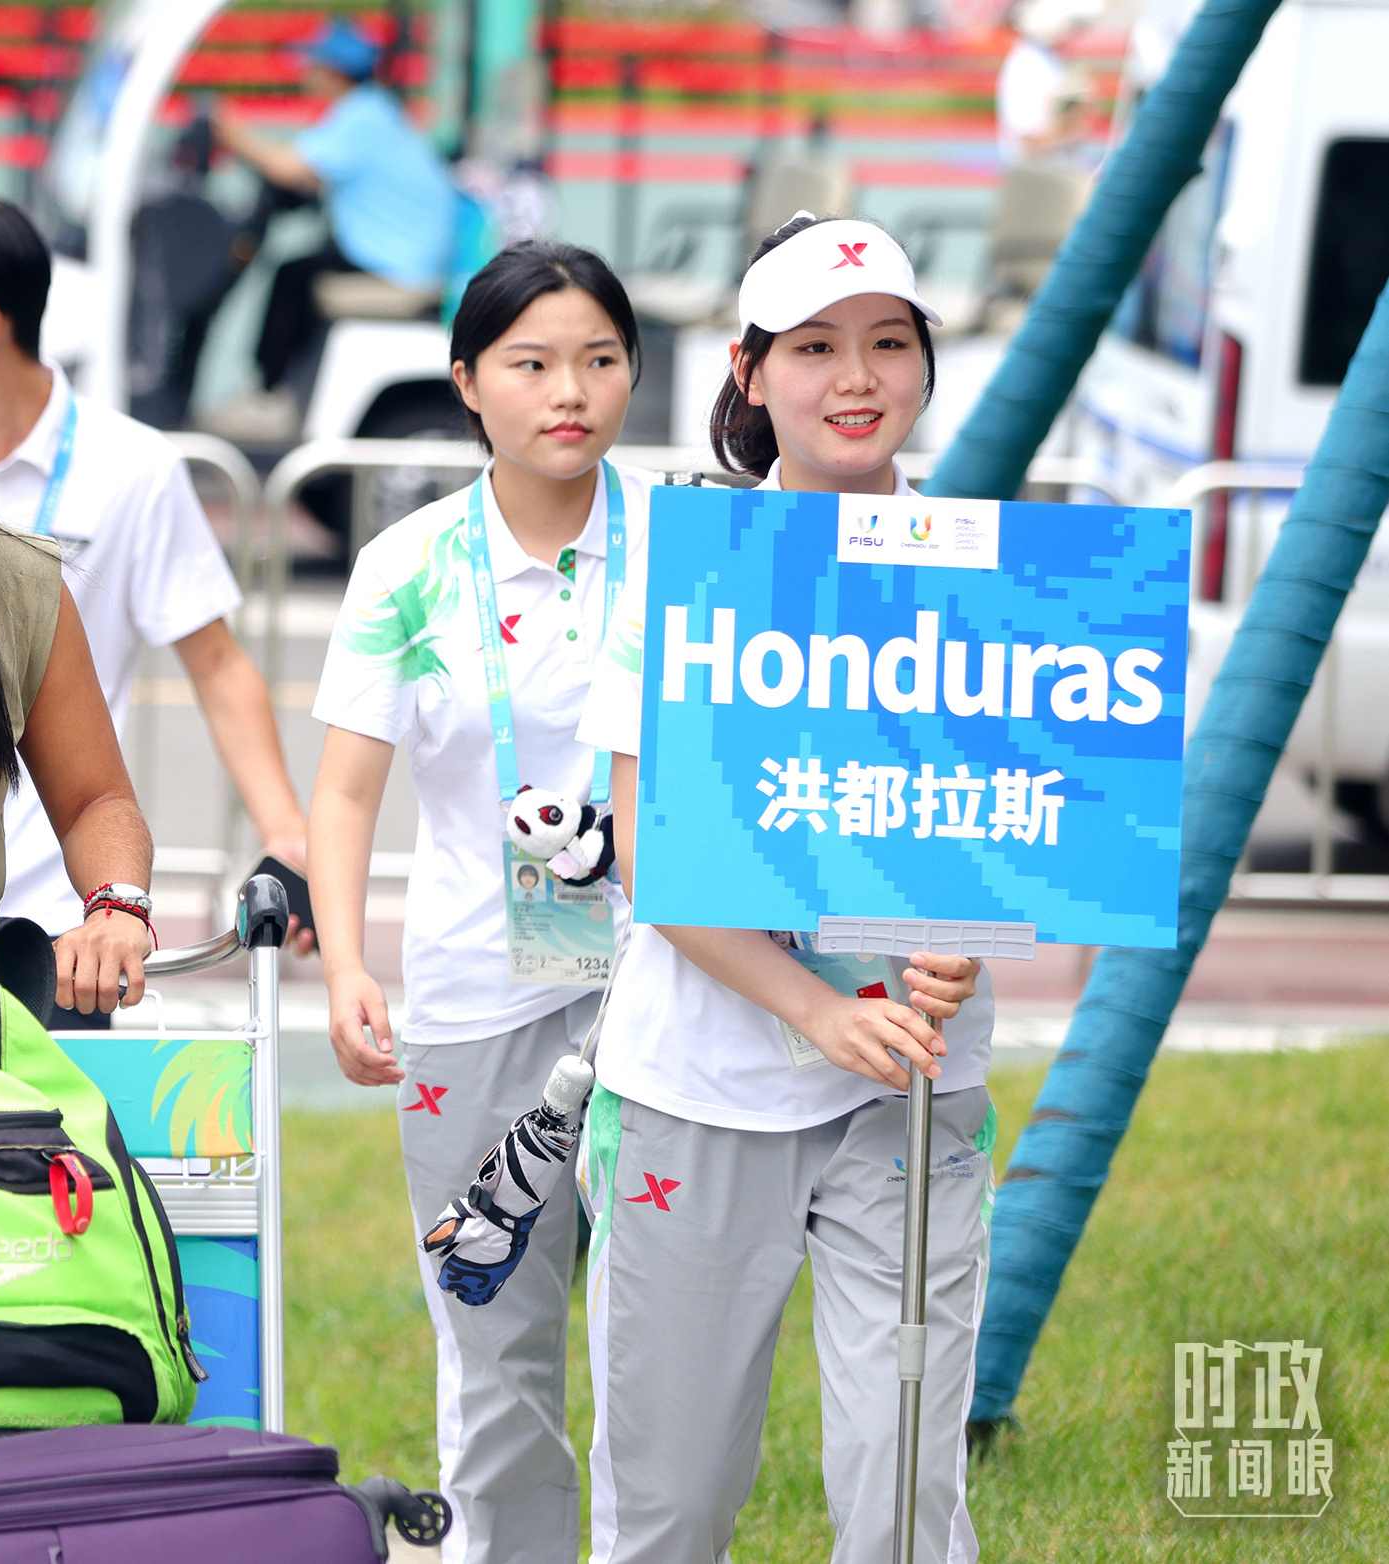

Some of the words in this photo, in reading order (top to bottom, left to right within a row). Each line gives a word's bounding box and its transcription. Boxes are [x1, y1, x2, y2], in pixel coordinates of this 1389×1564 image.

[848, 536, 884, 547] FISU
[662, 605, 1164, 725] Honduras
[755, 756, 1065, 846] 洪都拉斯
[576, 957, 610, 970] 1234
